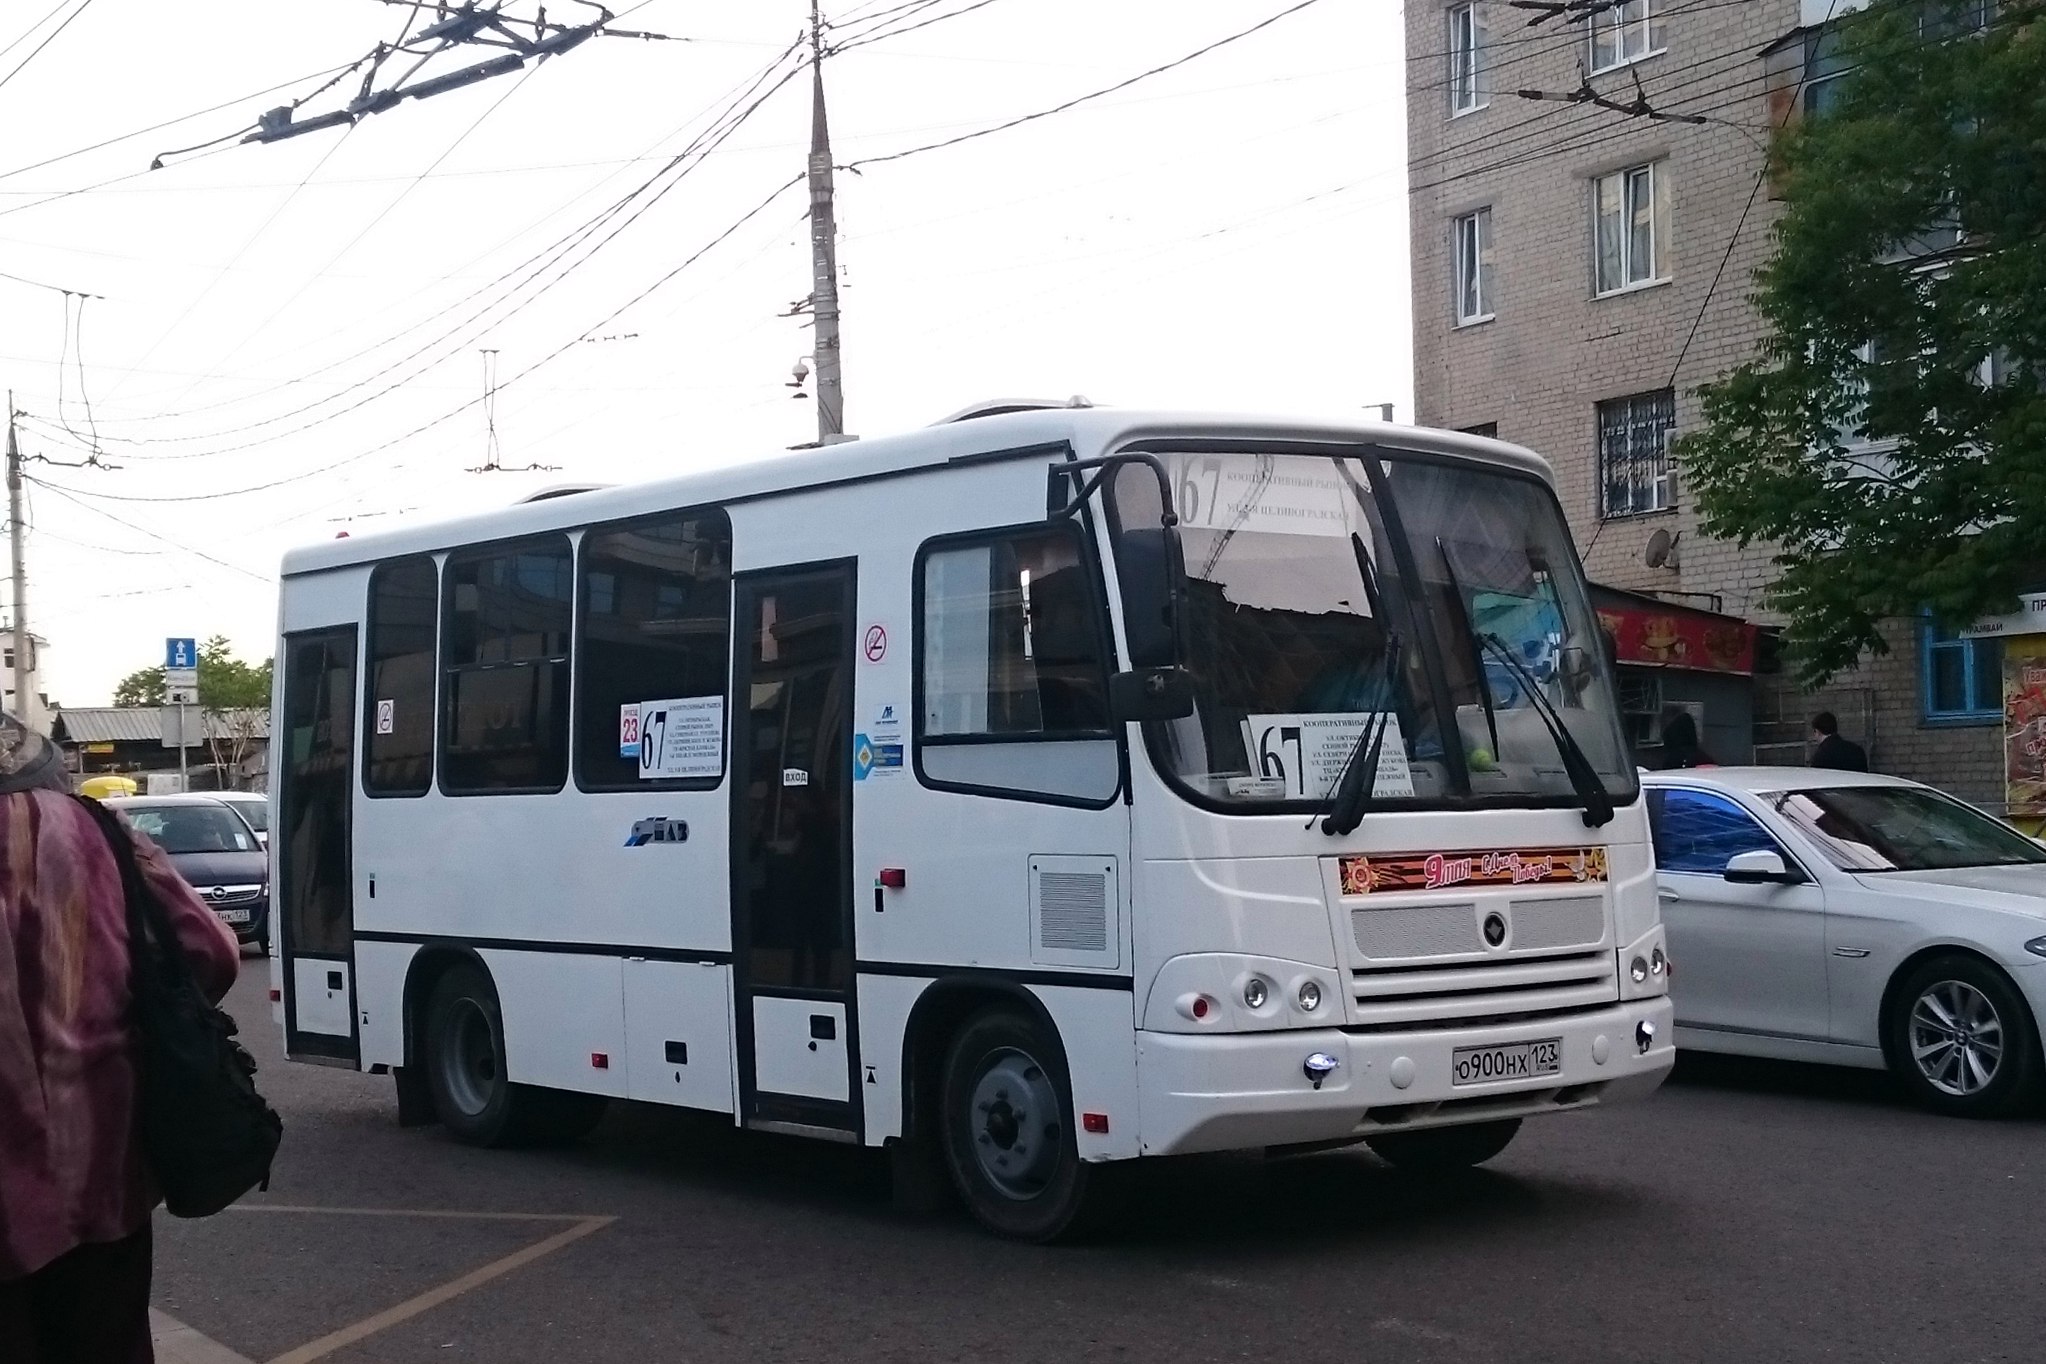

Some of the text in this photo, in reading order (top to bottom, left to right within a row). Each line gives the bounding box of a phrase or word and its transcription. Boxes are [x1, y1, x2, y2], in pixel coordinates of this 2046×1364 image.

[1179, 456, 1222, 526] 67
[623, 718, 638, 743] 23
[642, 711, 667, 769] 67
[785, 772, 807, 783] ВХОД
[1260, 726, 1304, 795] 67
[1531, 1044, 1557, 1064] 123
